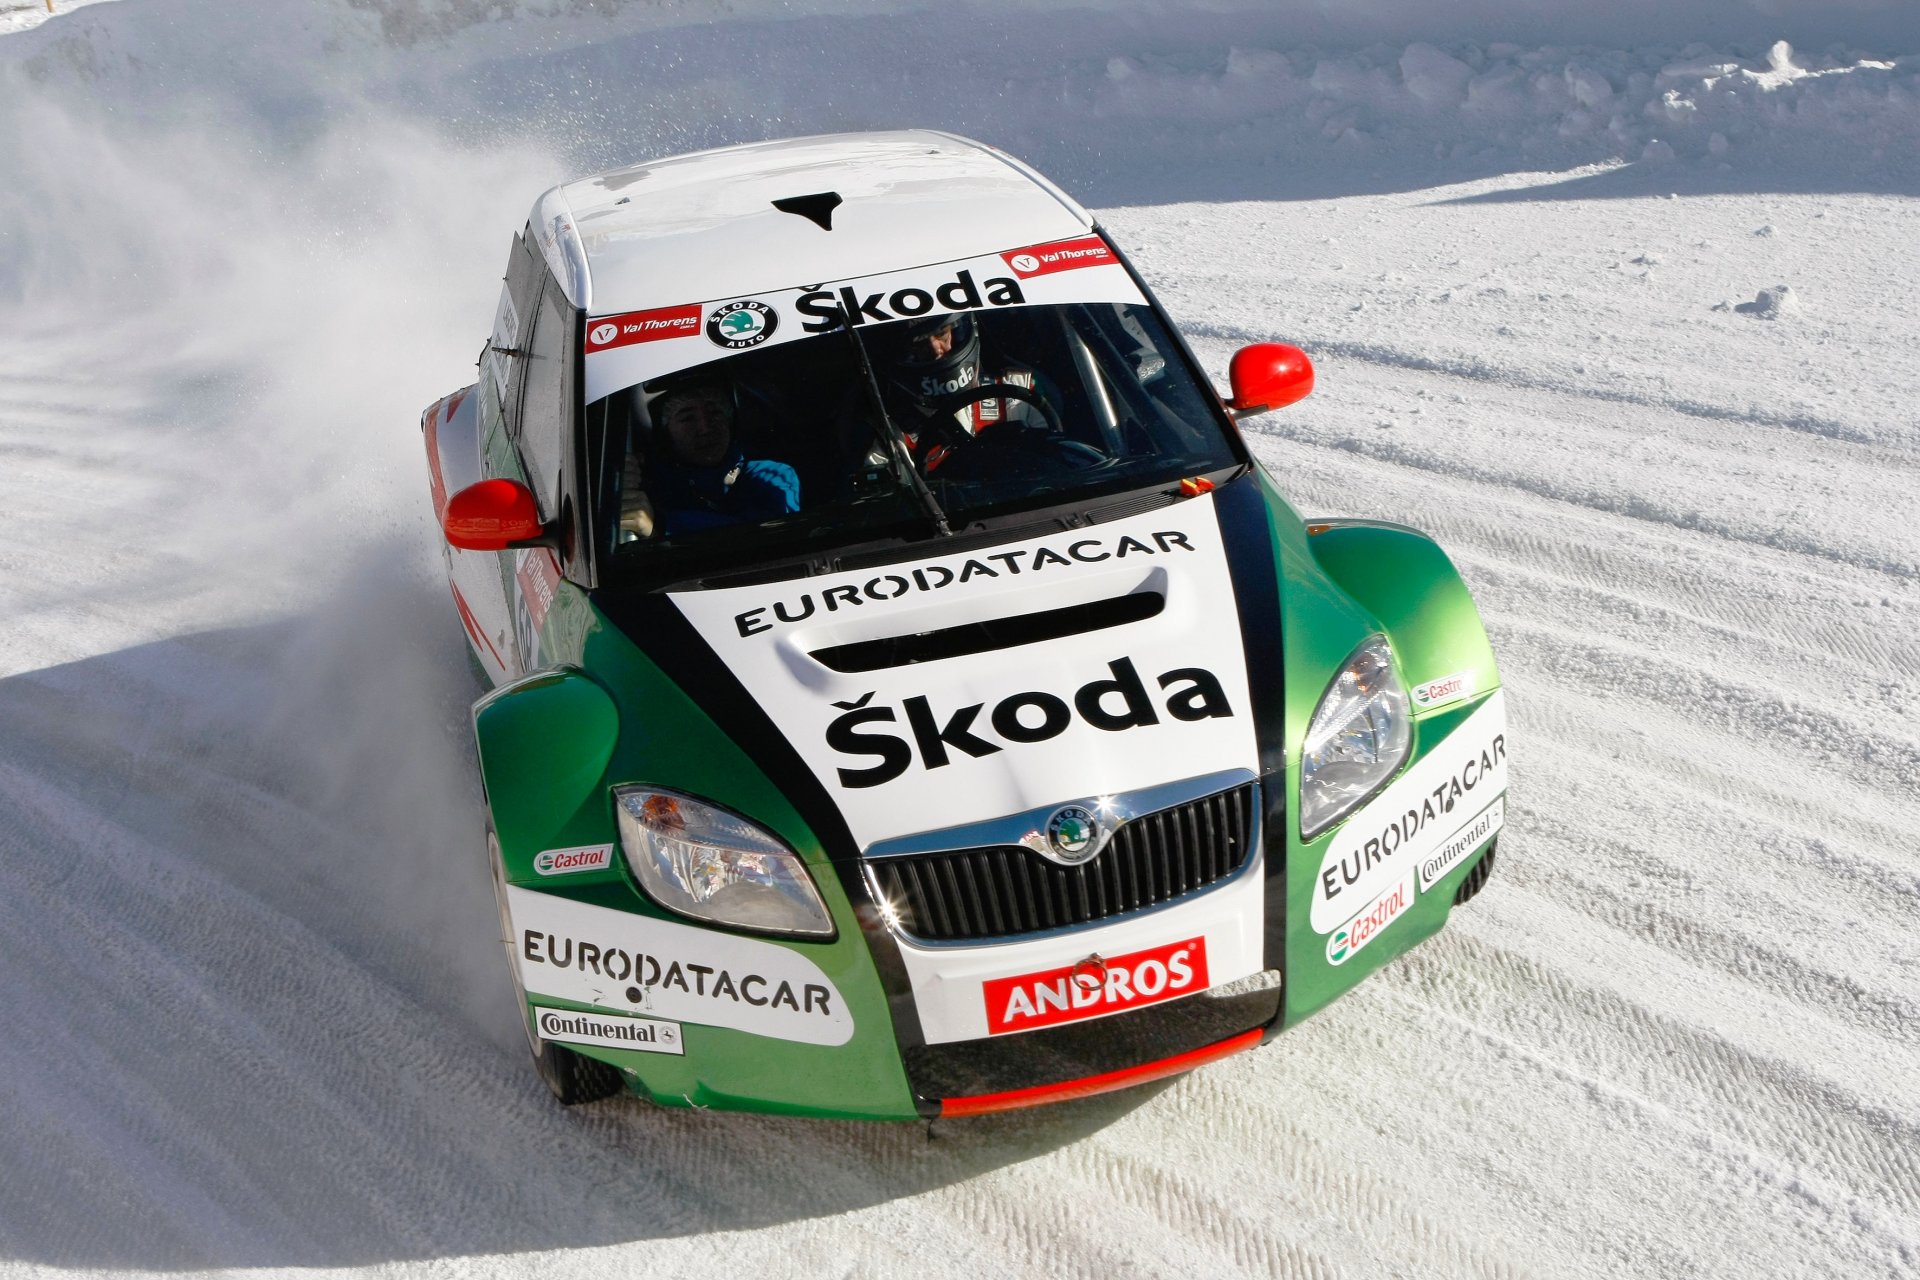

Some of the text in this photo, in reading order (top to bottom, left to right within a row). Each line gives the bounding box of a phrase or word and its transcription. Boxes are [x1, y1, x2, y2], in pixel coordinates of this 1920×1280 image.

[1040, 251, 1060, 263] Val
[1060, 247, 1107, 260] Thorens
[623, 321, 643, 335] Val
[644, 316, 698, 331] Thorens
[795, 269, 1026, 333] Škoda
[727, 334, 765, 348] AUTO
[921, 365, 975, 397] Škoda
[530, 560, 555, 613] Thorens
[735, 530, 1196, 638] EURODATACAR
[825, 657, 1234, 789] Škoda
[1322, 733, 1506, 900] EURODATACAR
[554, 848, 605, 869] Castrol
[1422, 816, 1491, 884] Continental
[1349, 882, 1405, 949] Castrol
[524, 929, 831, 1016] EURODATACAR
[1002, 950, 1193, 1024] ANDROS
[540, 1011, 658, 1043] Continental
